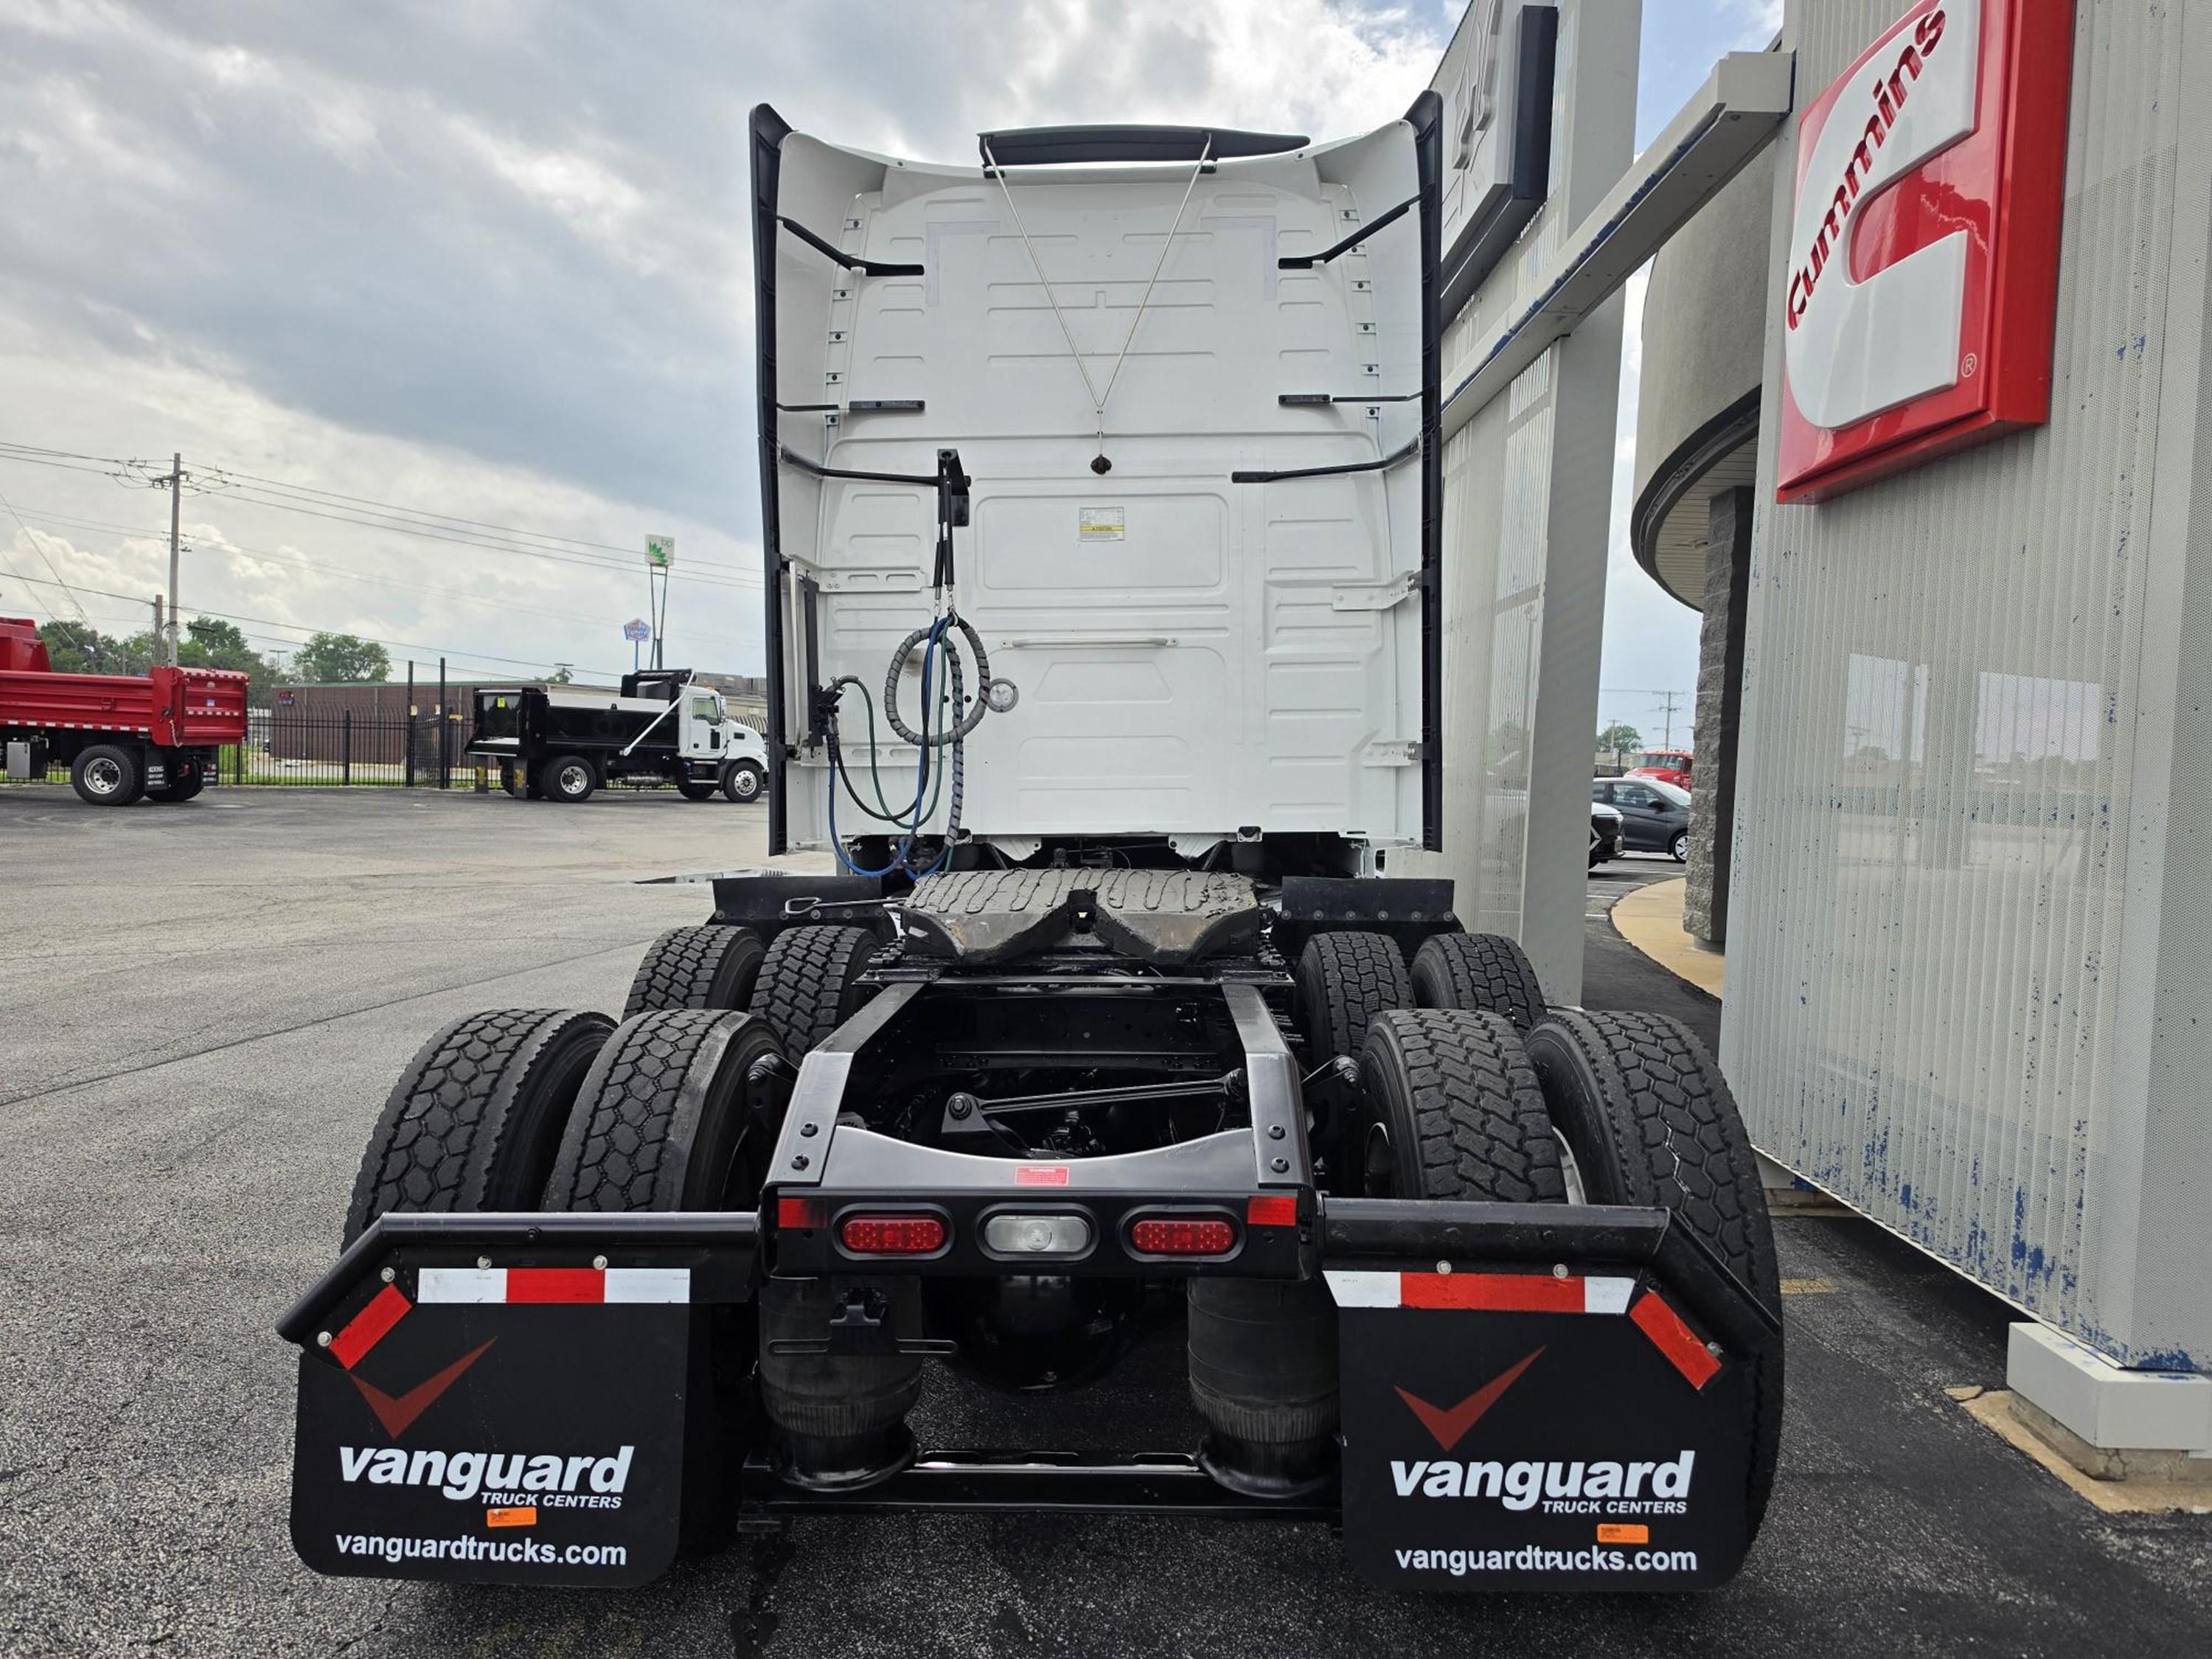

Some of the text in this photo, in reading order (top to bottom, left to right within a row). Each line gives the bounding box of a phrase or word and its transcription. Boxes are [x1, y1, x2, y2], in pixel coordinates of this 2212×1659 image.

[1787, 9, 1947, 332] Cummins
[339, 1445, 635, 1500] vanguard
[1390, 1450, 1695, 1511] vanguard
[481, 1492, 622, 1509] TRUCK CENTERS
[1542, 1500, 1687, 1514] TRUCK CENTERS
[335, 1534, 627, 1565] vanguardtrucks.com
[1395, 1545, 1697, 1576] vanguardtrucks.com
